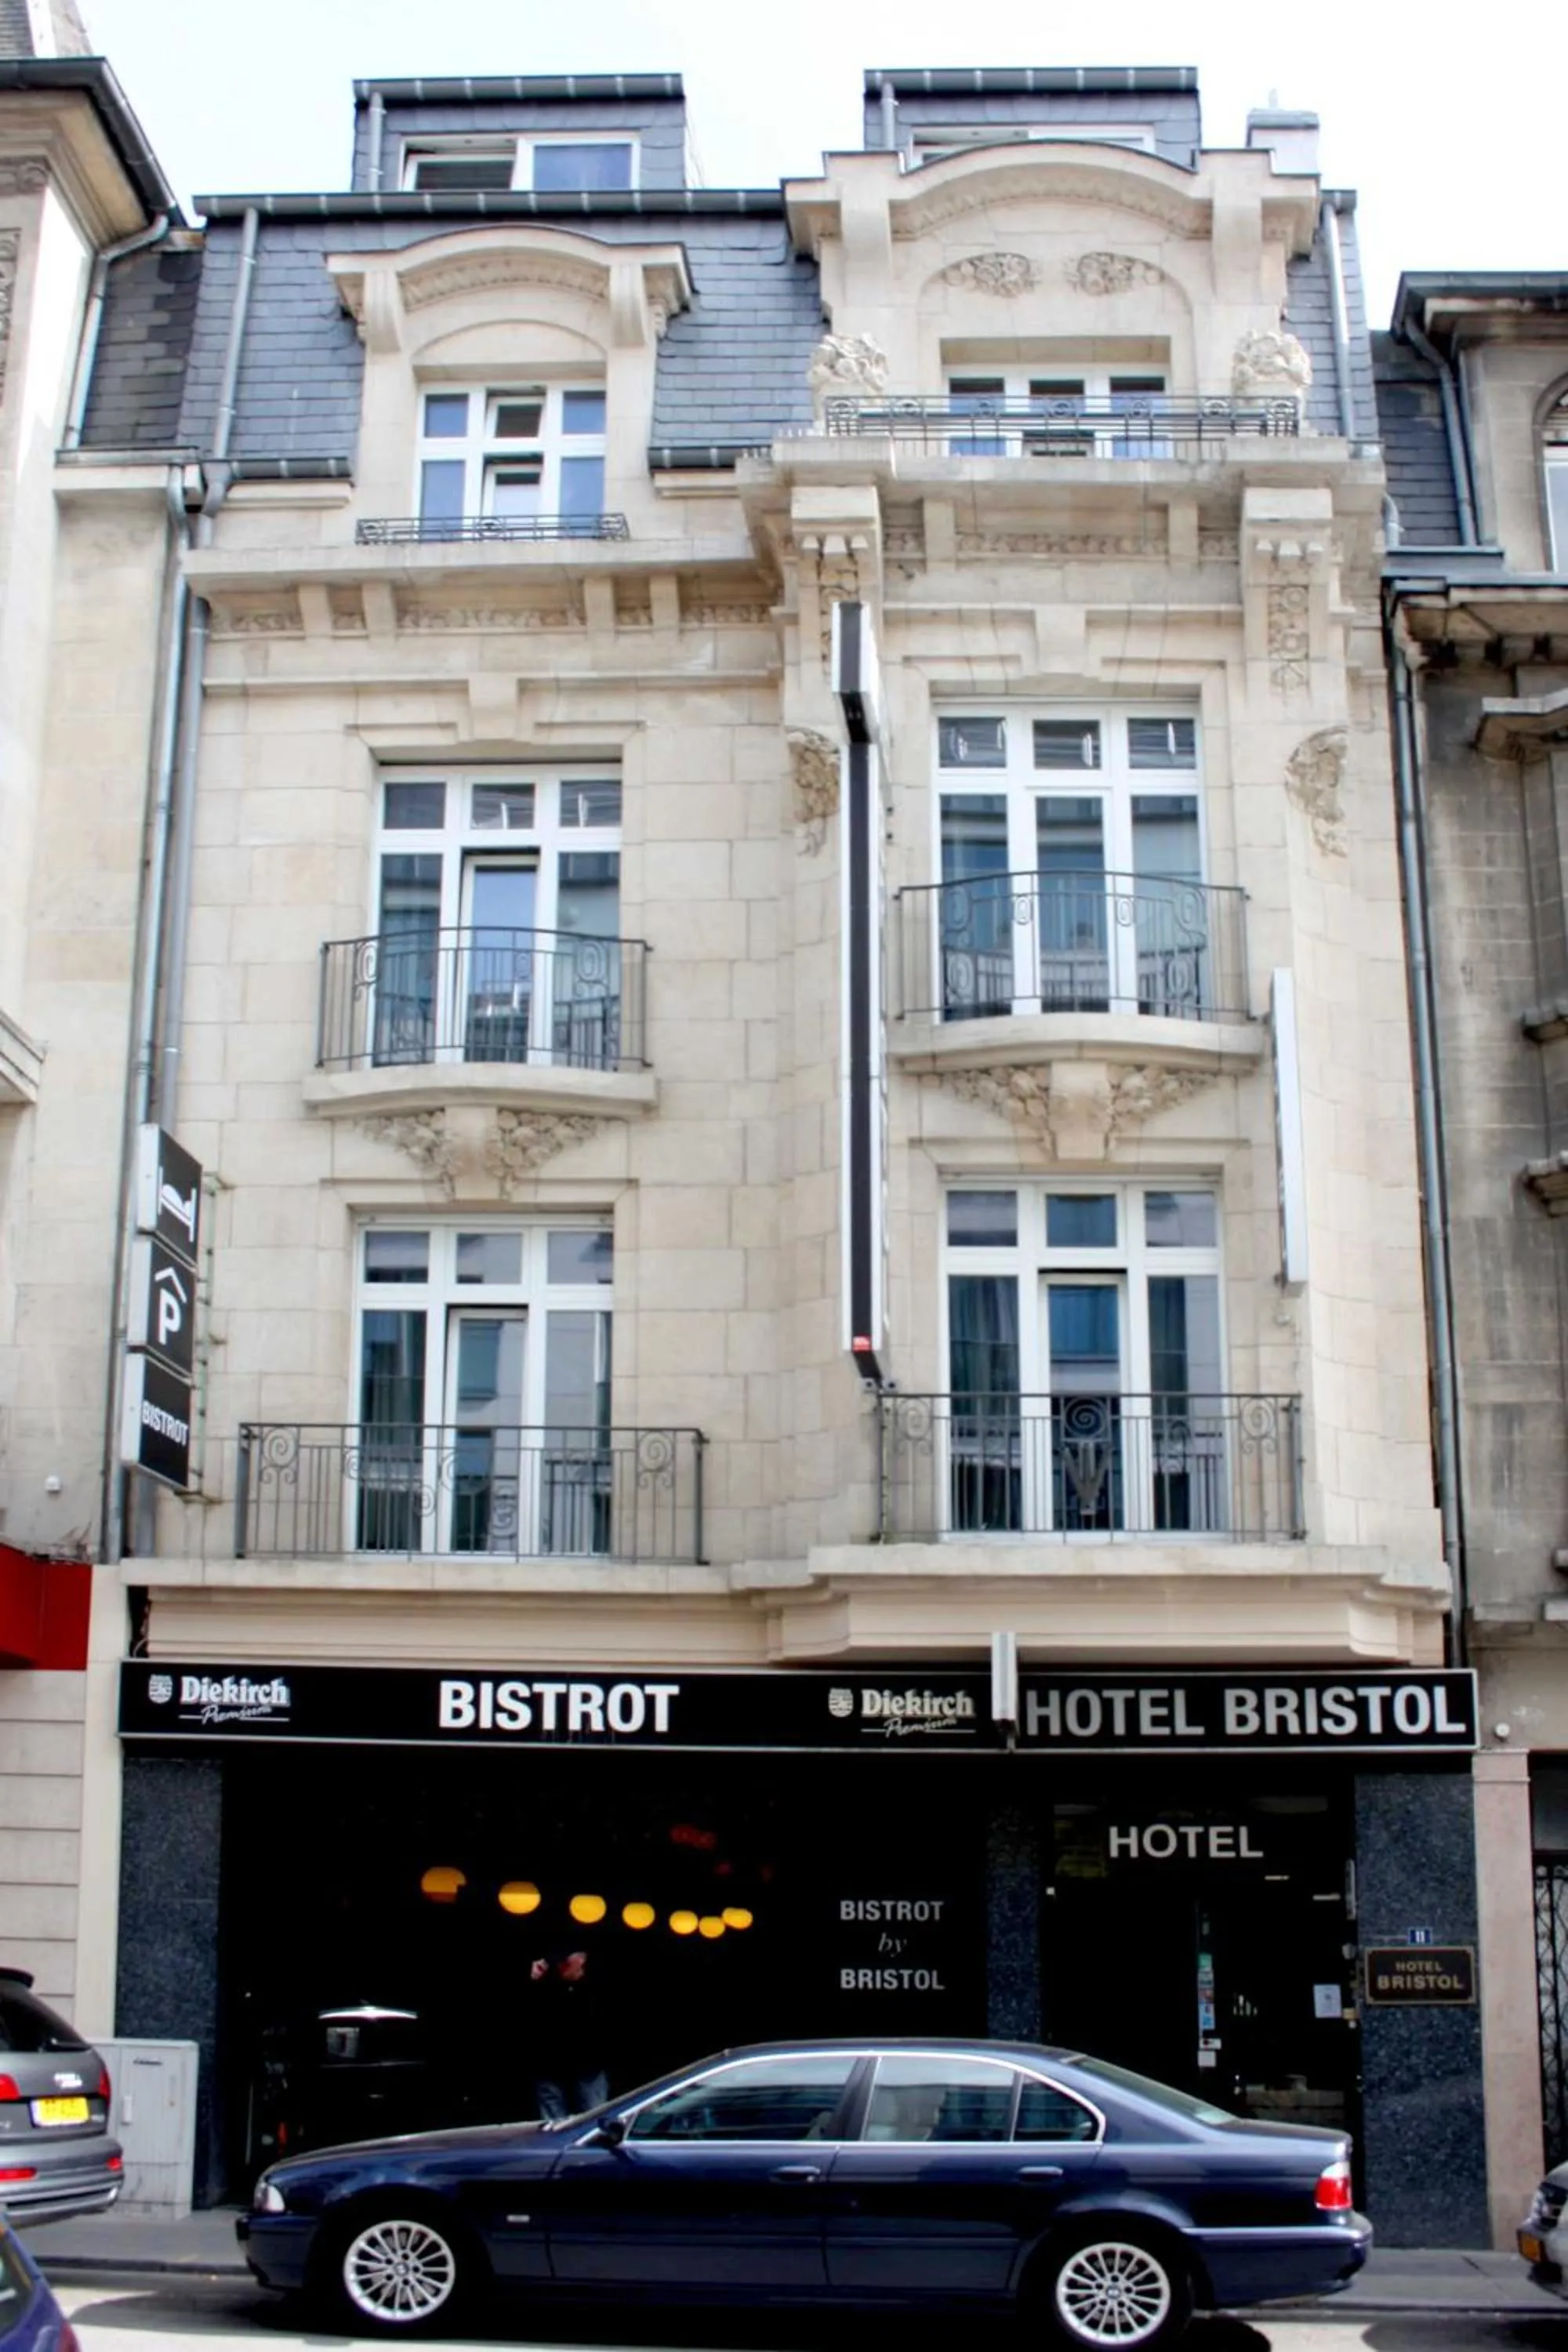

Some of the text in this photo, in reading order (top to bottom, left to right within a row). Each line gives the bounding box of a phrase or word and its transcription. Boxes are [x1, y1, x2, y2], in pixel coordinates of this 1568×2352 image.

[143, 1400, 188, 1446] BISTROT
[180, 1675, 290, 1706] Diekirch
[862, 1689, 975, 1717] Diekirch
[439, 1680, 680, 1733] BISTROT
[1027, 1685, 1466, 1736] HOTEL BRISTOL
[1109, 1824, 1264, 1858] HOTEL
[840, 1900, 944, 1921] BISTROT
[877, 1932, 908, 1958] by
[840, 1969, 945, 1990] BRISTOL
[1395, 1961, 1443, 1973] HOTEL
[1377, 1974, 1465, 1990] BRISTOL
